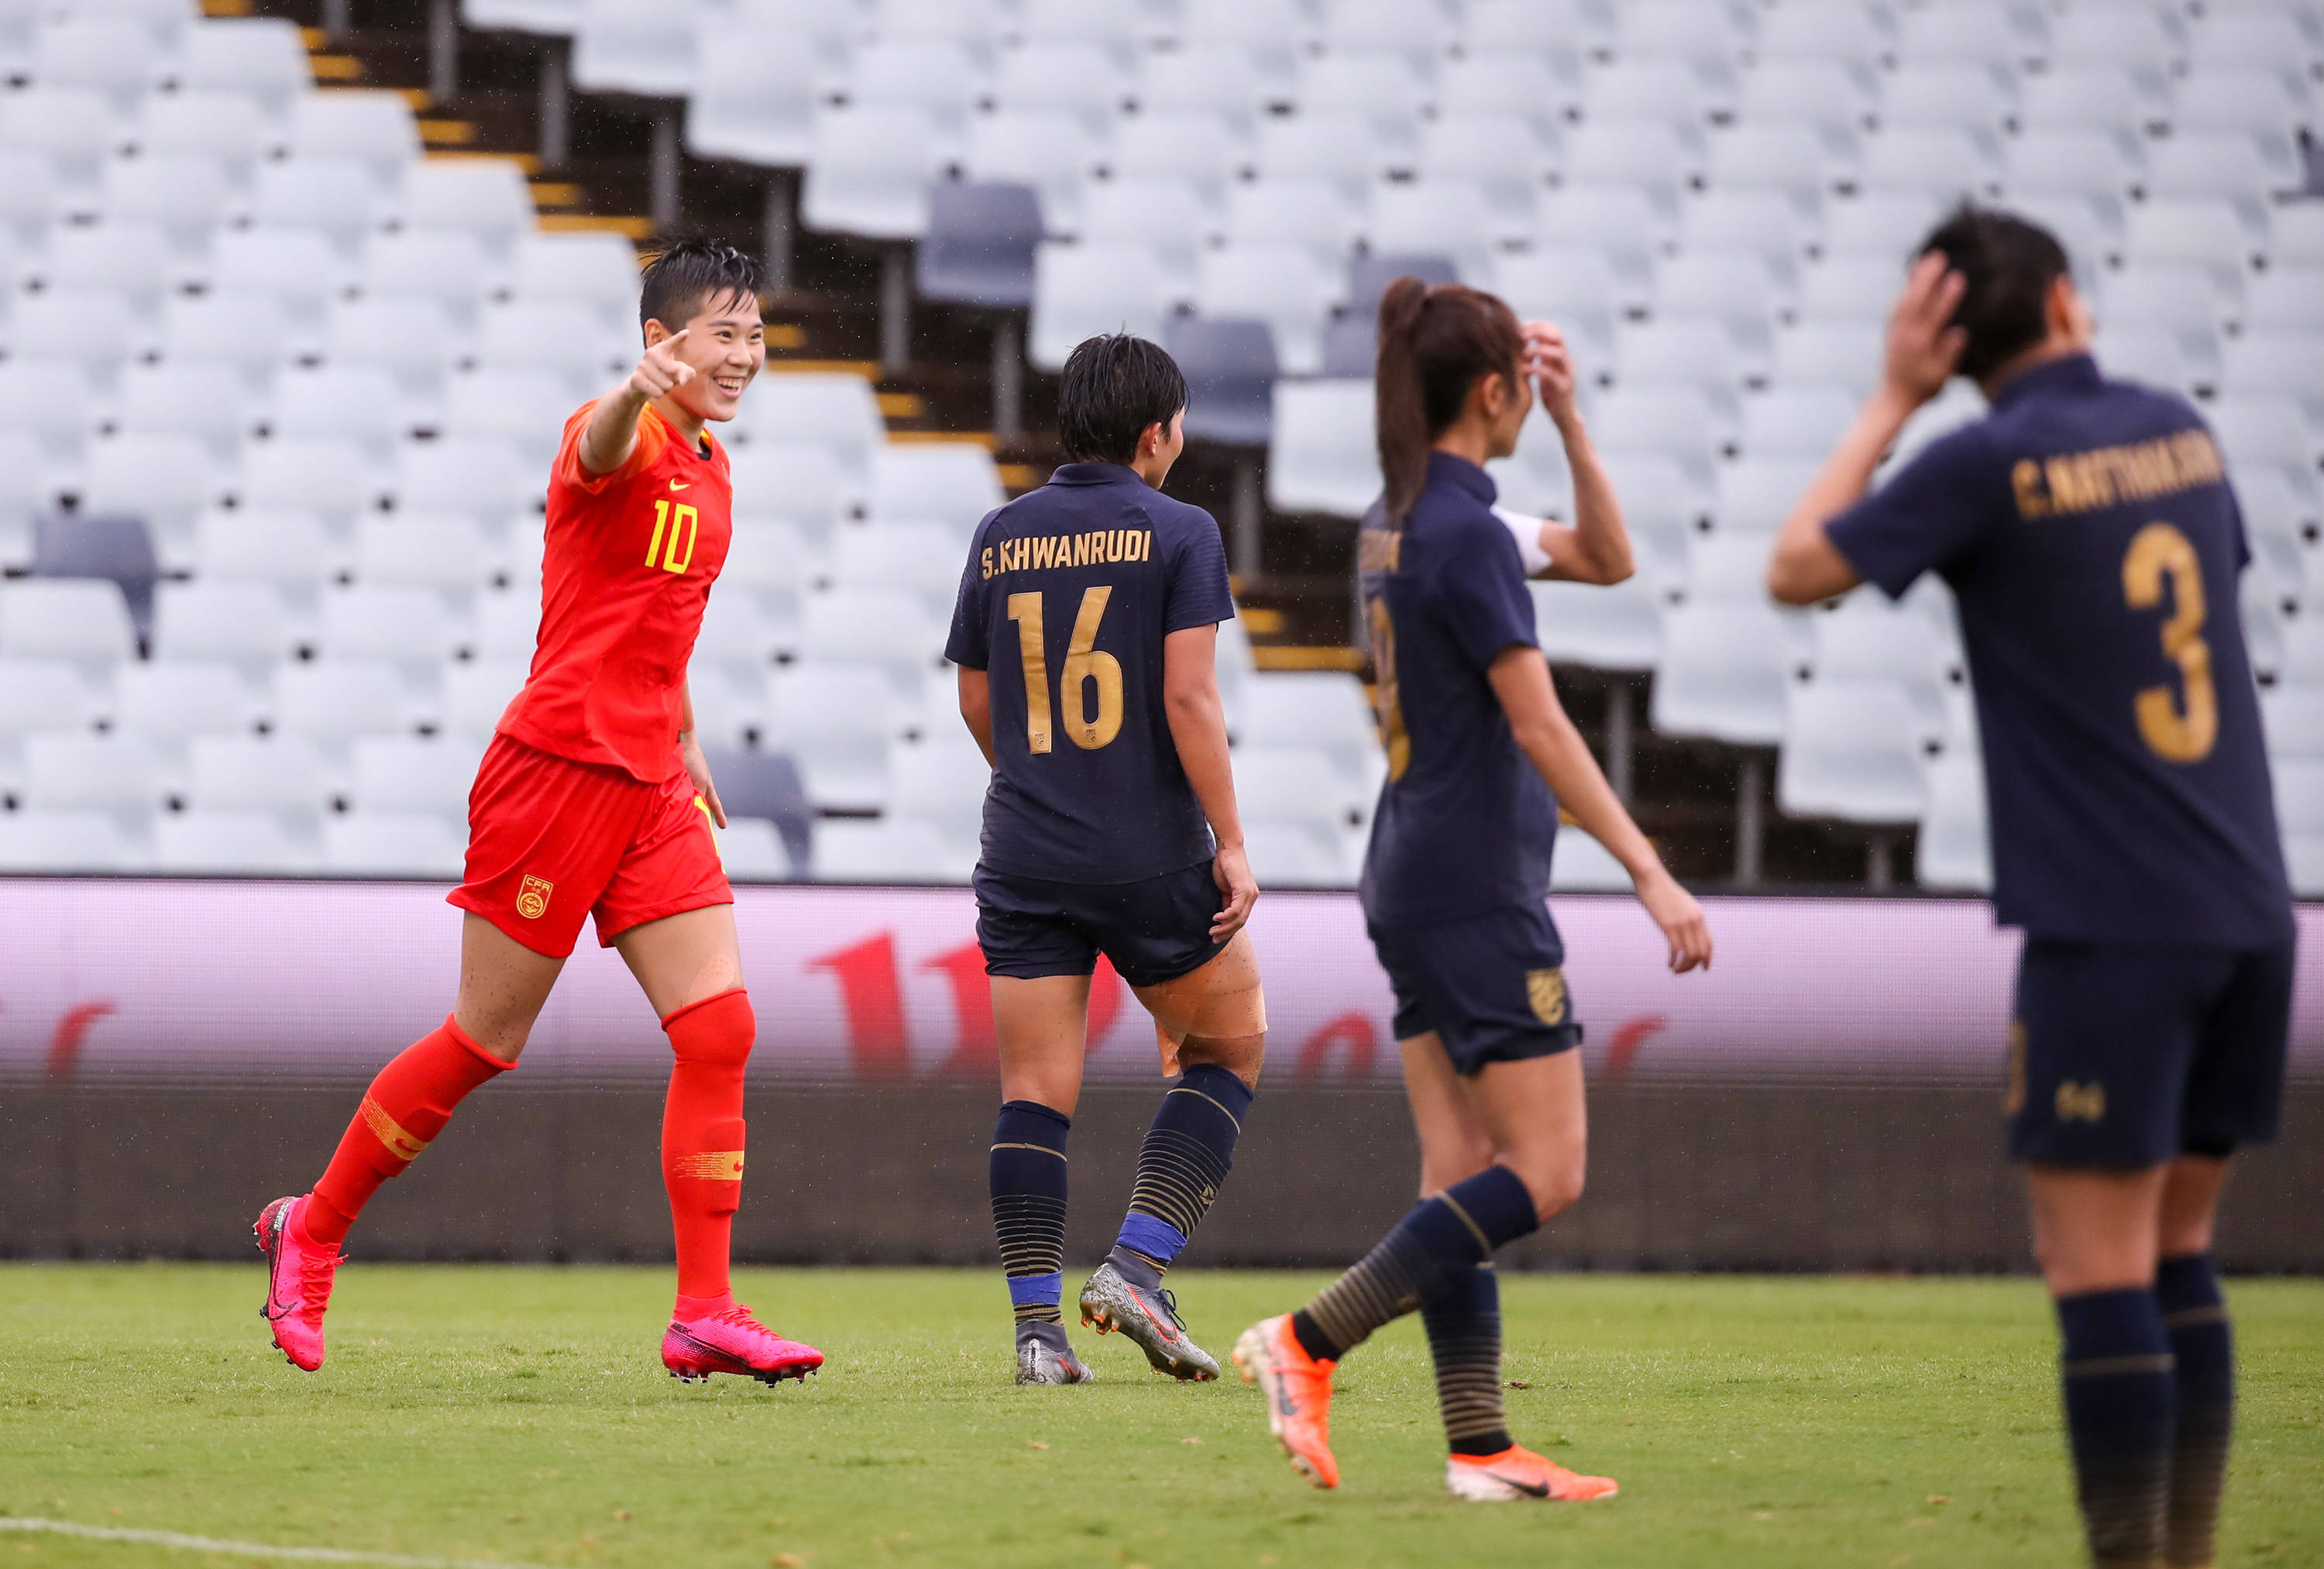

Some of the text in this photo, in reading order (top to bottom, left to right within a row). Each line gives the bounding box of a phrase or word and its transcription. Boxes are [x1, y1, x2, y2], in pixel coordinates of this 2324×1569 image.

[645, 499, 698, 574] 10
[982, 529, 1152, 580] S.KHWANRUDI
[1007, 586, 1124, 755] 16
[2121, 522, 2219, 765] 3
[526, 877, 551, 892] CFA
